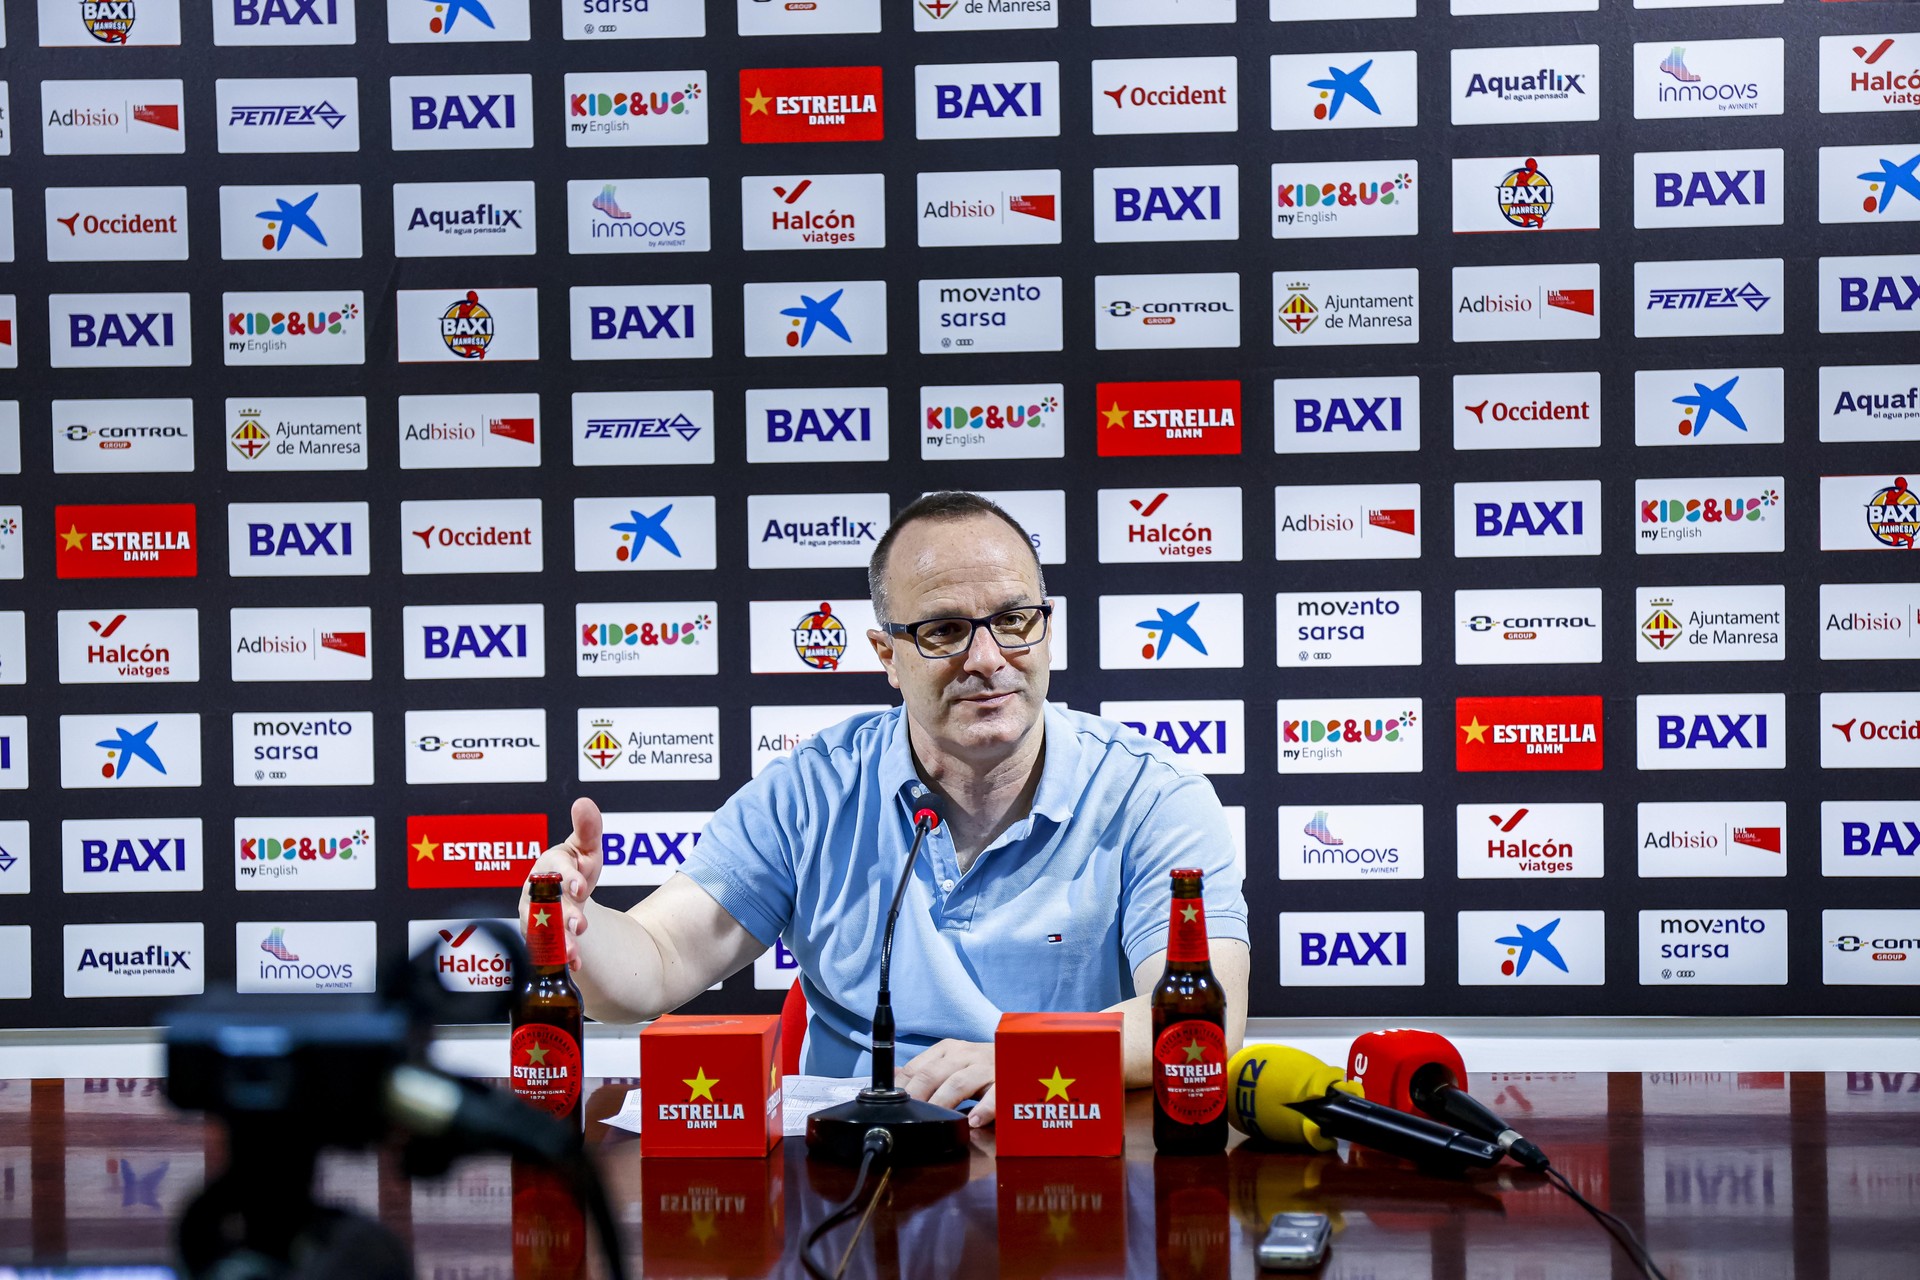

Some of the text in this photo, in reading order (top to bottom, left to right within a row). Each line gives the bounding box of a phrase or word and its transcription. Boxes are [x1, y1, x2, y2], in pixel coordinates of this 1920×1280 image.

[84, 0, 135, 17] BAXI
[233, 0, 337, 26] BAXI
[584, 0, 648, 13] sarsa
[965, 0, 1050, 13] de Manresa
[1465, 69, 1585, 102] Aquaflix
[1659, 82, 1758, 102] inmoovs
[571, 92, 685, 116] KIDS&US
[777, 95, 877, 114] ESTRELLA
[934, 82, 1041, 119] BAXI
[1130, 85, 1226, 106] Occident
[1513, 94, 1532, 102] agua
[1534, 92, 1569, 101] pensada
[48, 108, 119, 126] Adbisio
[229, 106, 316, 126] PENTEX
[410, 94, 515, 130] BAXI
[809, 115, 845, 125] DAMM
[571, 121, 629, 134] my English
[1278, 182, 1395, 207] KIDS&US
[1499, 186, 1552, 203] BAXI
[1654, 170, 1765, 207] BAXI
[923, 200, 995, 218] Adbisio
[1113, 186, 1220, 222] BAXI
[1509, 205, 1545, 216] MANRESA
[83, 214, 177, 234] Occident
[407, 204, 522, 235] Aquaflix
[772, 209, 855, 230] Halcón
[1278, 211, 1337, 225] my English
[592, 219, 685, 238] inmoovs
[802, 231, 855, 244] viatges
[940, 284, 1040, 302] movento
[1647, 288, 1739, 310] PENTEX
[1143, 302, 1234, 313] CONTROL
[1325, 295, 1413, 312] Ajuntament
[1459, 294, 1532, 313] Adbisio
[229, 312, 342, 335] KIDS&US
[443, 318, 493, 334] BAXI
[589, 305, 694, 340] BAXI
[941, 312, 1006, 327] sarsa
[1146, 317, 1173, 325] GROUP
[1325, 314, 1412, 328] de Manresa
[69, 313, 173, 347] BAXI
[229, 340, 286, 353] my English
[927, 405, 1041, 429] KIDS&US
[1134, 409, 1234, 428] ESTRELLA
[1294, 397, 1401, 433] BAXI
[1492, 401, 1590, 421] Occident
[99, 427, 187, 438] CONTROL
[276, 422, 361, 439] Ajuntament
[405, 423, 475, 440] Adbisio
[585, 418, 671, 438] PENTEX
[765, 408, 870, 443] BAXI
[1166, 428, 1202, 438] DAMM
[277, 440, 360, 454] de Manresa
[927, 434, 985, 447] my English
[1474, 501, 1583, 537] BAXI
[1641, 498, 1761, 523] KIDS&US
[762, 516, 876, 547] Aquaflix
[1281, 514, 1353, 532] Adbisio
[1878, 523, 1914, 534] MANRESA
[92, 532, 190, 550] ESTRELLA
[248, 522, 352, 556] BAXI
[438, 527, 531, 547] Occident
[1129, 522, 1212, 543] Halcón
[1642, 527, 1701, 541] my English
[124, 551, 158, 561] DAMM
[1159, 543, 1212, 557] viatges
[1298, 597, 1400, 616] movento
[1503, 617, 1596, 628] CONTROL
[1689, 611, 1780, 628] Ajuntament
[1826, 613, 1901, 631] Adbisio
[422, 624, 527, 659] BAXI
[582, 622, 695, 646] KIDS&US
[796, 629, 847, 645] BAXI
[1298, 626, 1364, 641] sarsa
[1689, 630, 1778, 644] de Manresa
[88, 644, 169, 663] Halcón
[237, 636, 307, 653] Adbisio
[582, 650, 639, 663] my English
[118, 664, 170, 678] viatges
[254, 718, 352, 736] movento
[1283, 719, 1399, 743] KIDS&US
[1494, 724, 1596, 743] ESTRELLA
[1657, 714, 1767, 749] BAXI
[451, 738, 540, 748] CONTROL
[628, 732, 713, 749] Ajuntament
[1527, 744, 1563, 754] DAMM
[254, 746, 318, 760] sarsa
[455, 752, 481, 760] GROUP
[628, 750, 712, 764] de Manresa
[1284, 747, 1342, 760] my English
[1488, 838, 1573, 858] Halcón
[1644, 831, 1718, 848] Adbisio
[81, 838, 185, 873] BAXI
[240, 837, 353, 861] KIDS&US
[443, 842, 540, 860] ESTRELLA
[1303, 845, 1399, 864] inmoovs
[241, 865, 297, 878] my English
[475, 861, 510, 871] DAMM
[1519, 859, 1573, 874] viatges
[1661, 916, 1765, 934] movento
[1299, 932, 1407, 966] BAXI
[1661, 944, 1729, 958] sarsa
[77, 945, 191, 976] Aquaflix
[143, 967, 176, 975] pensada
[260, 961, 352, 979] inmoovs
[468, 974, 512, 987] viatge
[513, 1065, 568, 1079] ESTRELLA
[1165, 1063, 1222, 1076] ESTRELLA
[658, 1103, 745, 1120] ESTRELLA
[1013, 1103, 1101, 1120] ESTRELLA
[686, 1120, 717, 1129] DAMM
[1042, 1120, 1073, 1129] DAMM
